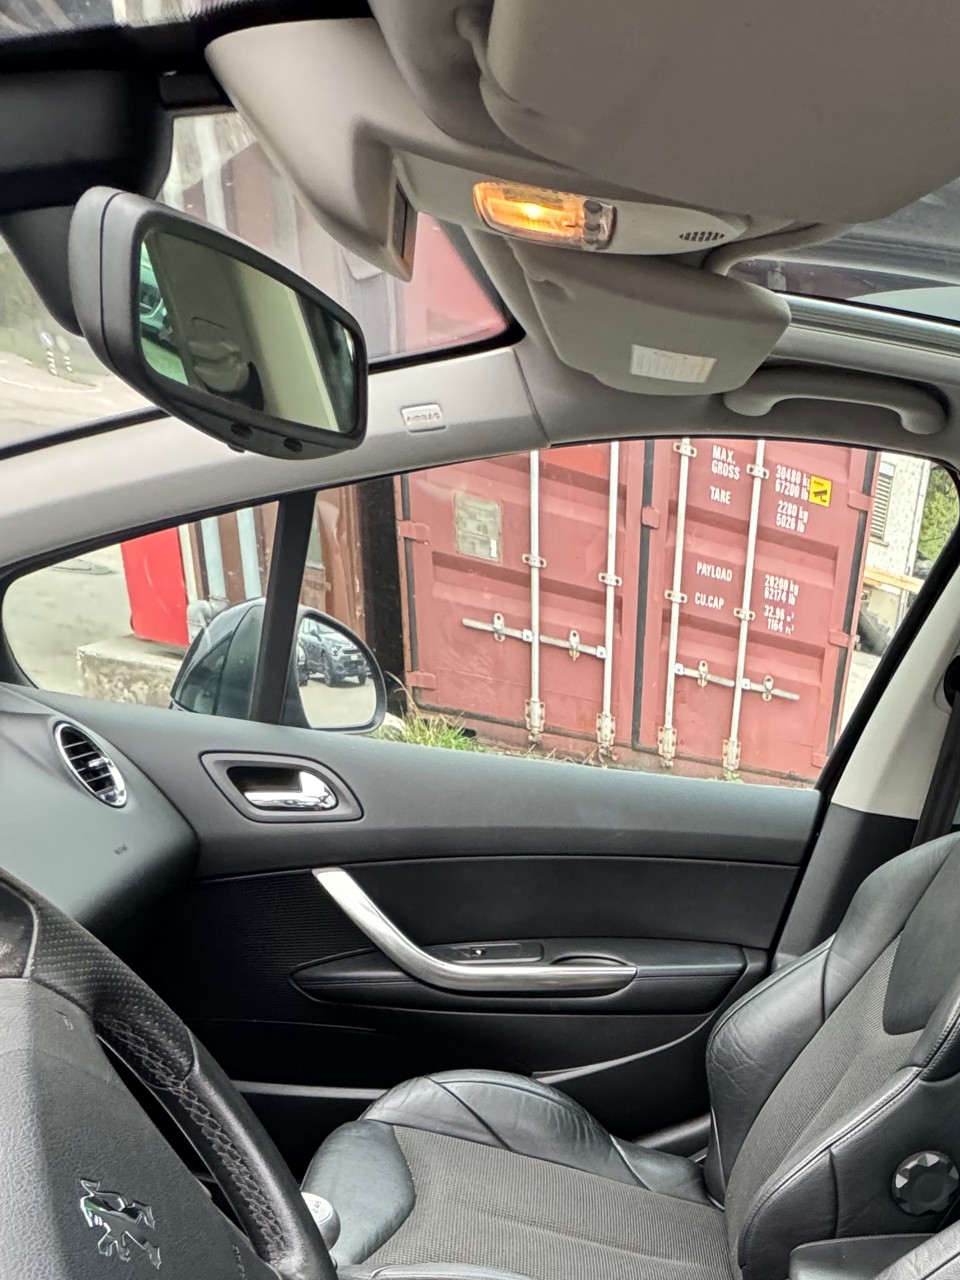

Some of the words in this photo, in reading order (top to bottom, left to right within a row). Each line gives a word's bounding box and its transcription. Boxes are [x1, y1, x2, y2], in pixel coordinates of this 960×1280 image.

[712, 444, 736, 465] MAX.
[711, 460, 740, 480] GROSS
[776, 464, 801, 484] 30480
[710, 485, 731, 505] TARE
[775, 479, 800, 498] 67200
[777, 500, 798, 517] 2280
[798, 506, 808, 523] kg
[776, 512, 796, 530] 5026
[797, 518, 805, 533] lb
[696, 561, 733, 582] PAYLOAD
[764, 586, 787, 604] 62174
[788, 593, 796, 605] lb
[789, 580, 799, 596] kg
[695, 592, 725, 610] CU.CAP
